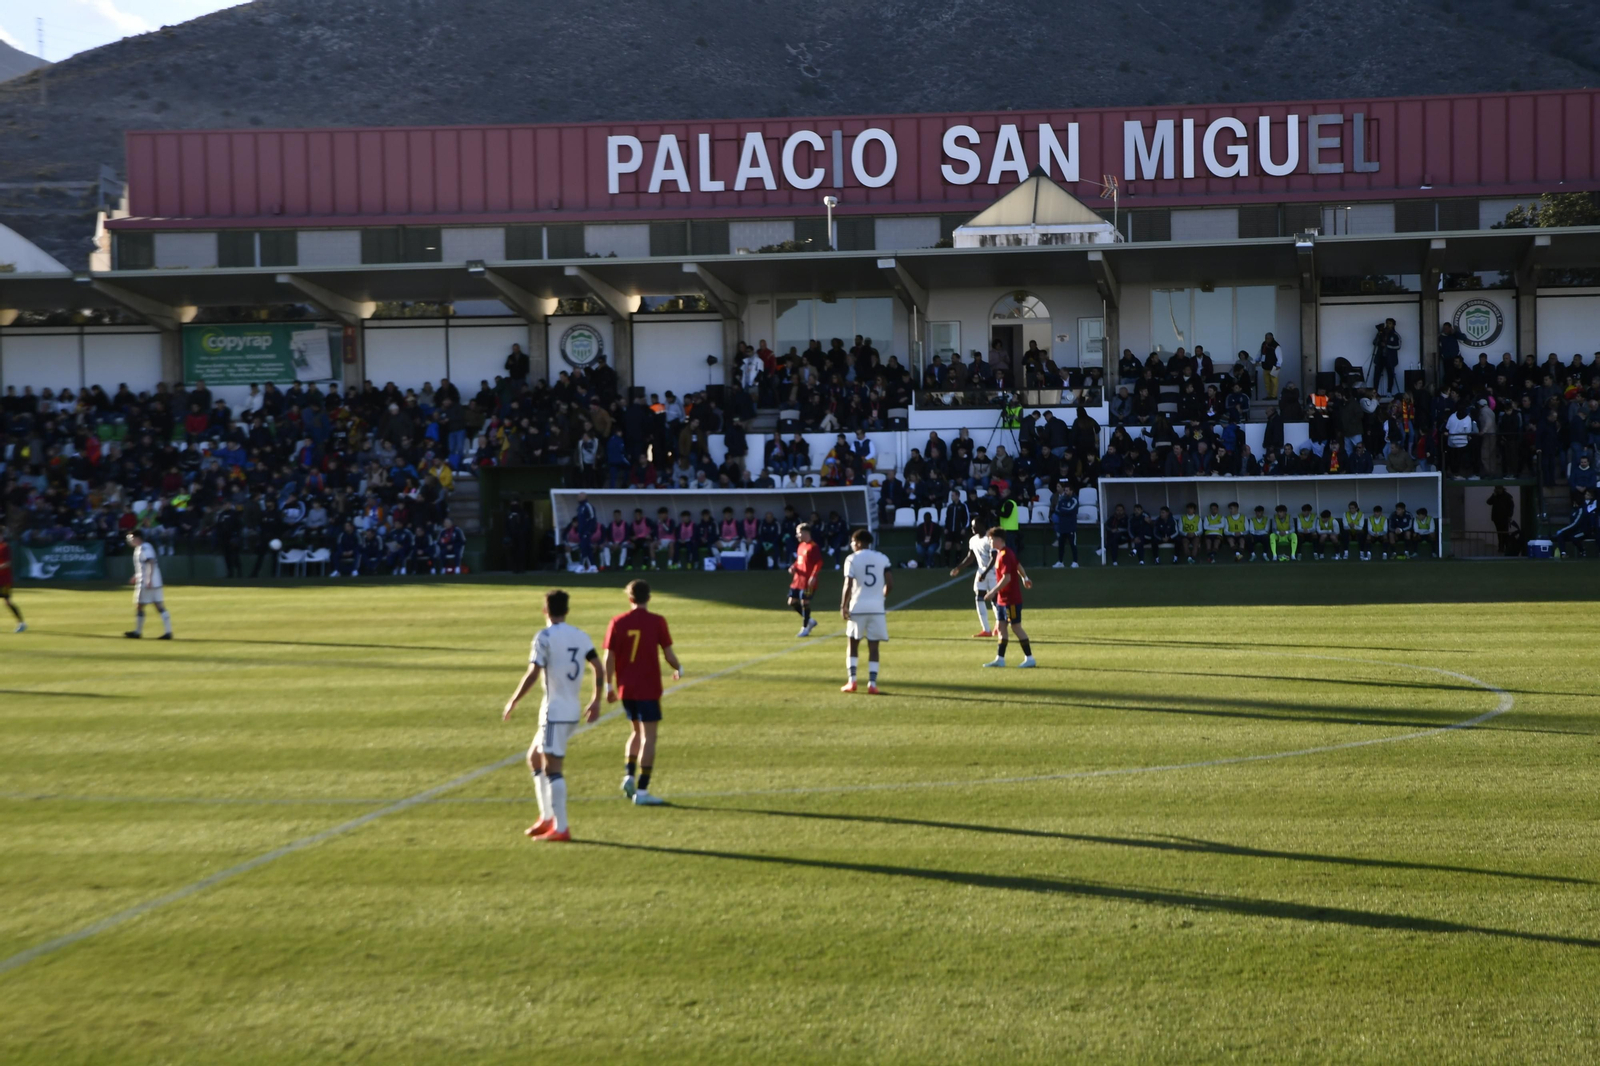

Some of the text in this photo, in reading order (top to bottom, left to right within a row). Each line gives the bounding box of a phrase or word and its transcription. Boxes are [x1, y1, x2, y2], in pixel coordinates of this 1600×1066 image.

[607, 112, 1380, 194] PALACIO SAN MIGUEL
[207, 334, 272, 350] copyrap
[52, 545, 86, 553] HOTEL
[863, 564, 877, 587] 5
[627, 629, 641, 663] 7
[566, 647, 580, 681] 3
